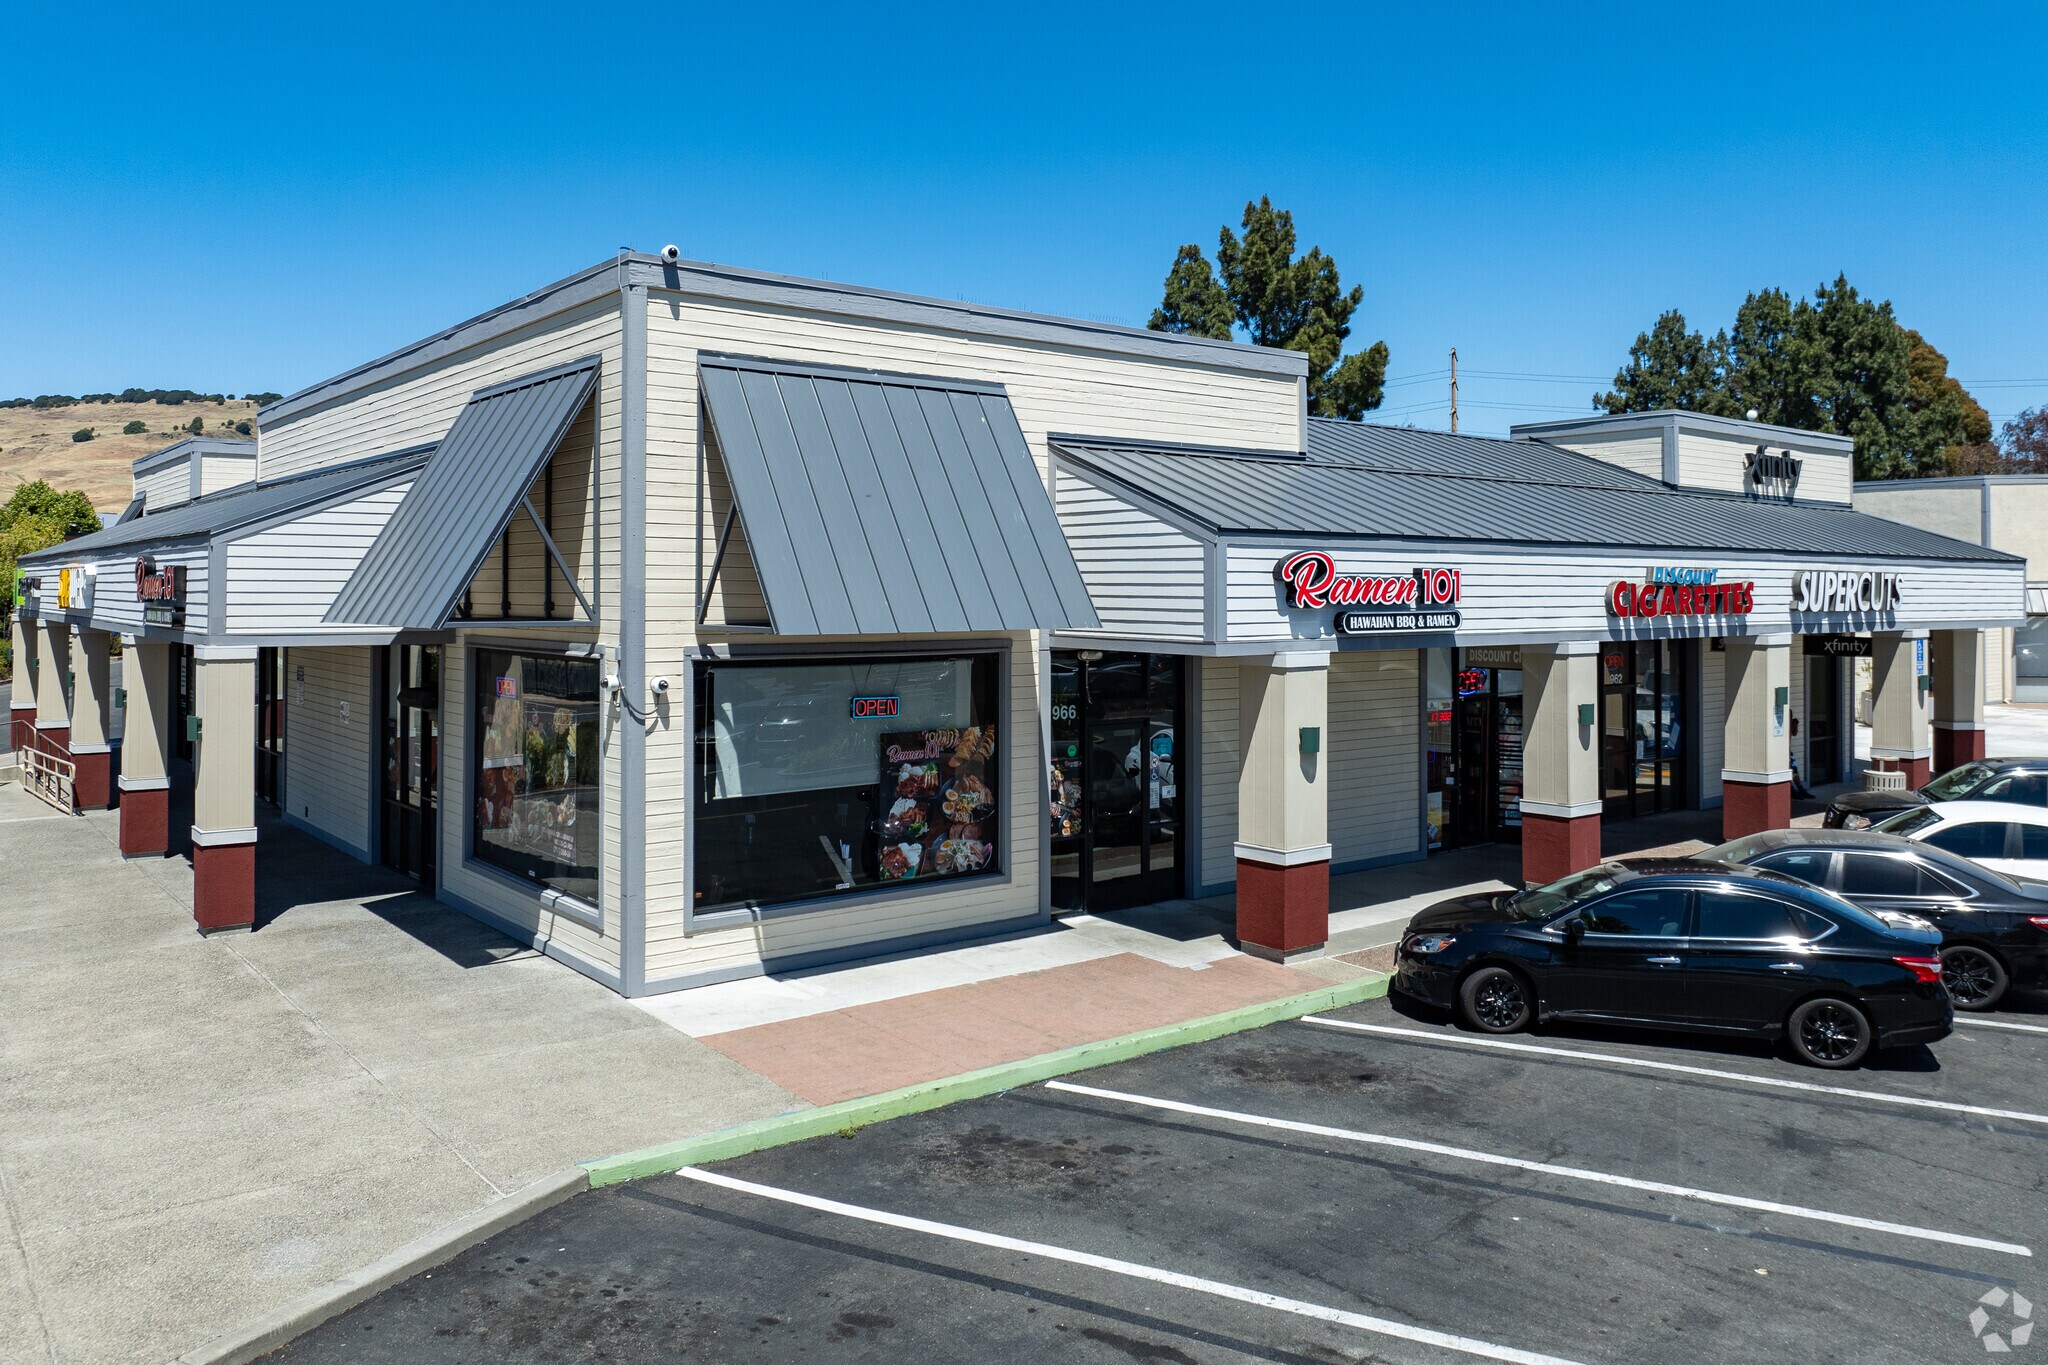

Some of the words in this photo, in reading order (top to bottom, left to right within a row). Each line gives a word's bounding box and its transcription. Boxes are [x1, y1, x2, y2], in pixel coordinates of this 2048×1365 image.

[1750, 444, 1803, 489] xfinity
[1282, 550, 1418, 609] Ramen
[1422, 568, 1462, 605] 101
[1653, 566, 1718, 584] DISCOUNT
[1612, 580, 1754, 618] CIGARETTES
[1797, 570, 1904, 612] SUPERCUTS
[1350, 615, 1394, 629] HAWAIIAN
[1396, 615, 1416, 629] BBQ
[1417, 615, 1425, 628] &
[1426, 614, 1456, 627] RAMEN
[1824, 638, 1868, 654] xfinity
[1469, 649, 1511, 663] DISCOUNT
[1604, 655, 1624, 668] OPEN
[1610, 673, 1623, 684] 962
[855, 699, 897, 716] OPEN
[1052, 704, 1077, 720] 966
[886, 744, 924, 763] Ramen
[924, 741, 940, 759] 101
